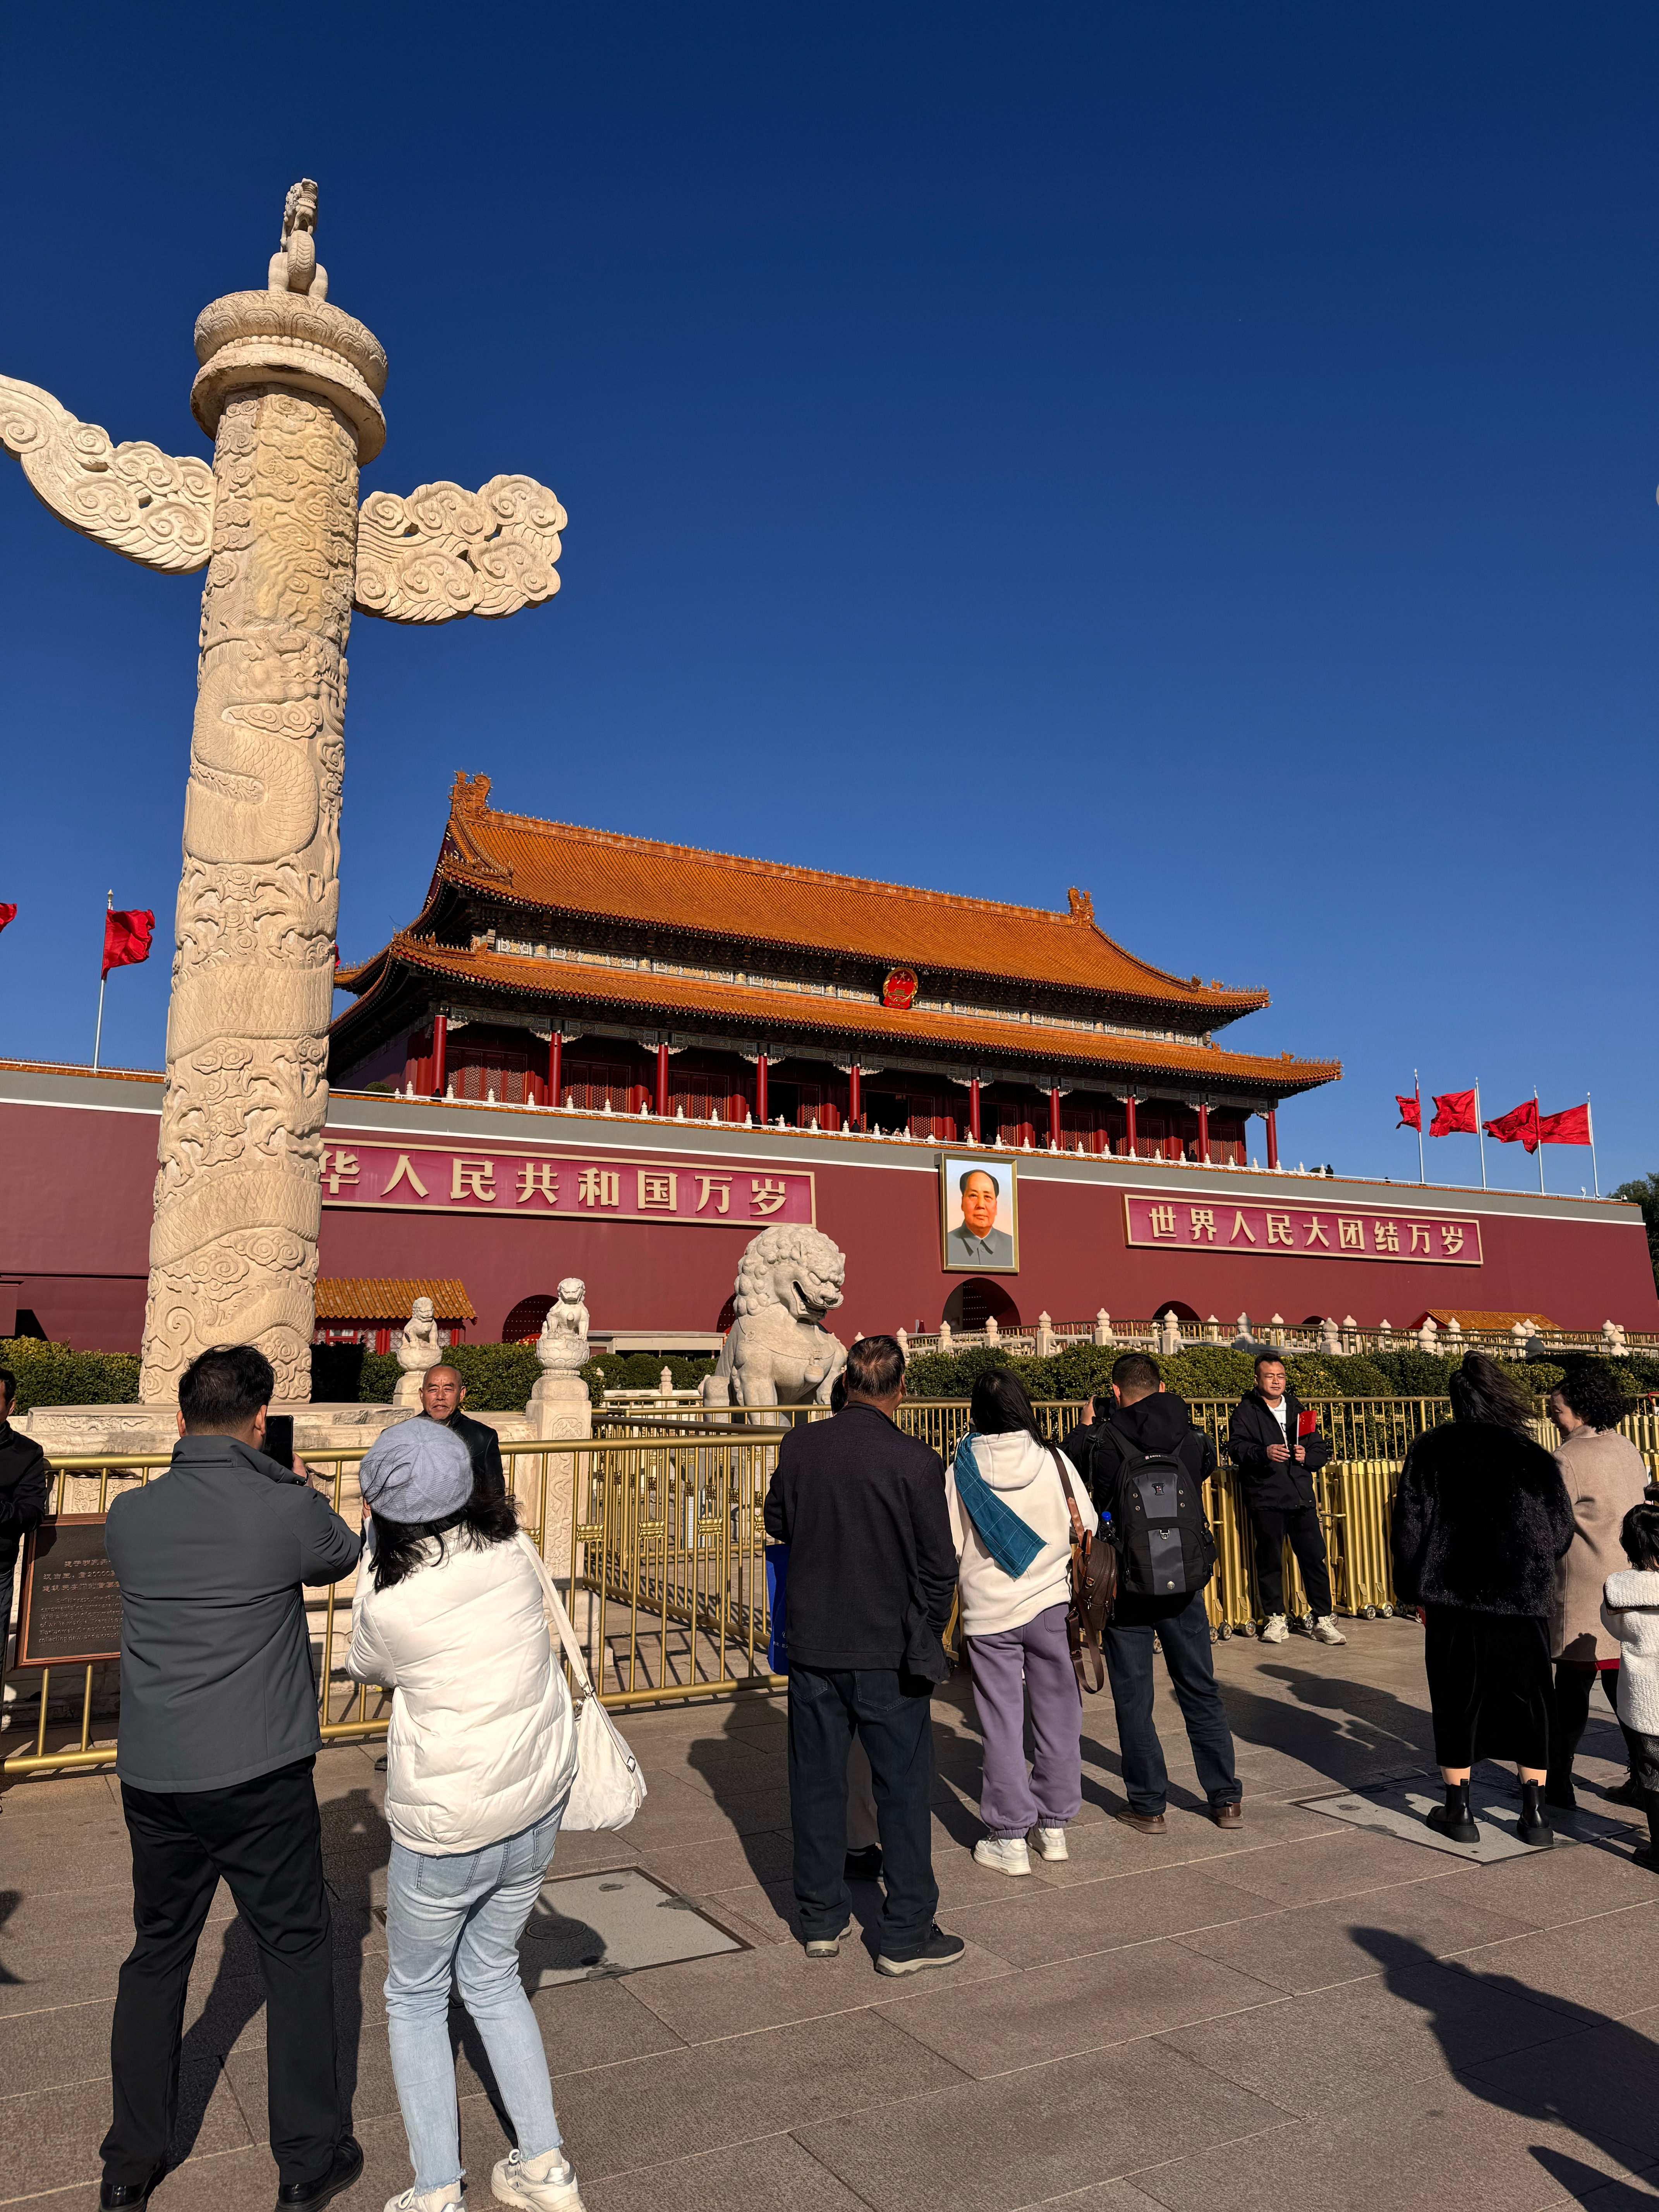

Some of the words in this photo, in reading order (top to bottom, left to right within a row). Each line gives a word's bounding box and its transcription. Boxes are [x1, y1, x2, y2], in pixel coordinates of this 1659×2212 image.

[319, 1150, 787, 1217] 华人民共和国万岁
[1148, 1206, 1464, 1255] 世界人民大团结万岁
